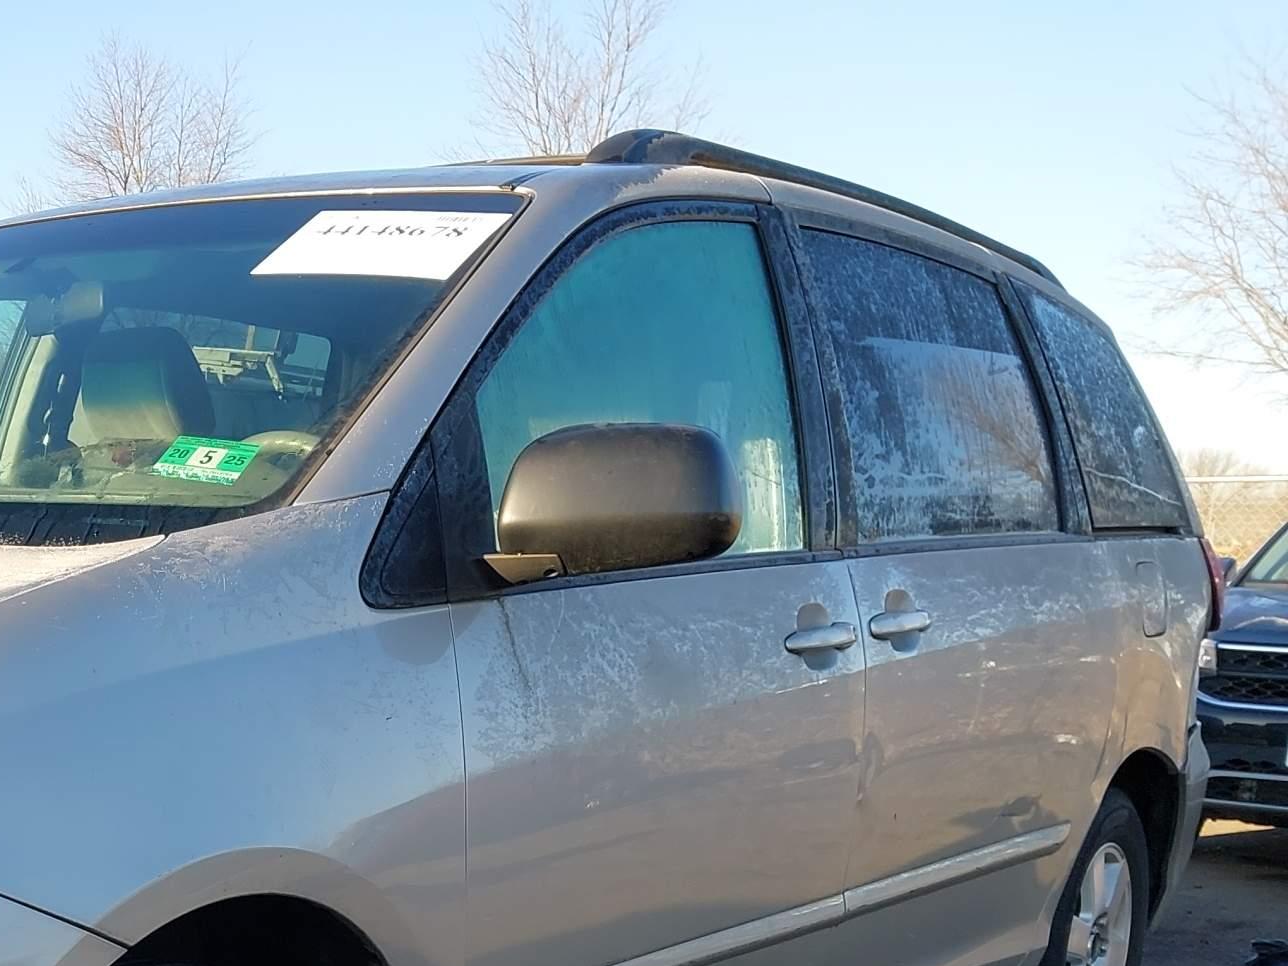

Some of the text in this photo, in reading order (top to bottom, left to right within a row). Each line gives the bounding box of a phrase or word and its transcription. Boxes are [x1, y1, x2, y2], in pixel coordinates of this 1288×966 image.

[169, 449, 247, 466] 20 5 25
